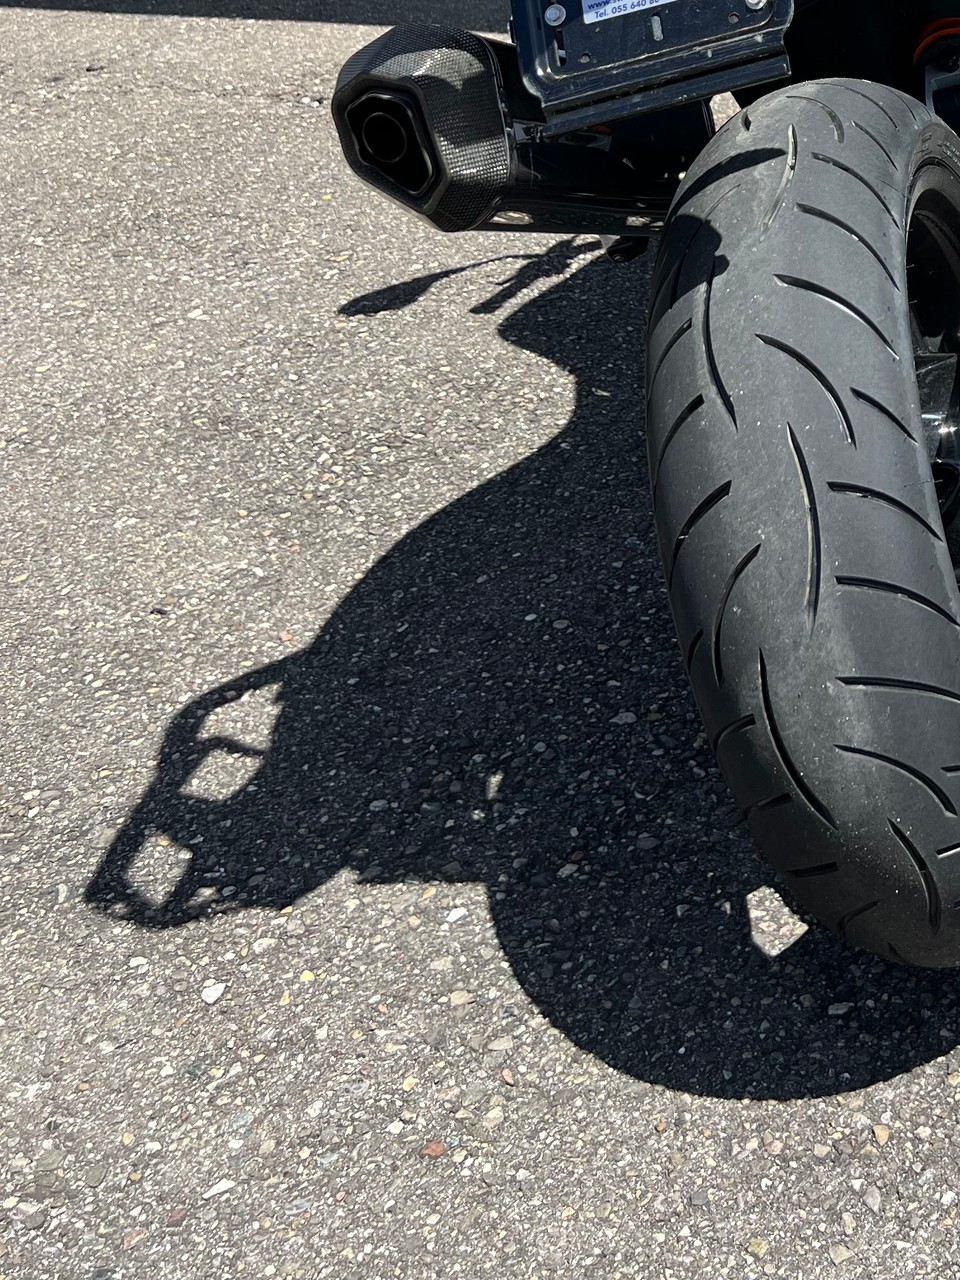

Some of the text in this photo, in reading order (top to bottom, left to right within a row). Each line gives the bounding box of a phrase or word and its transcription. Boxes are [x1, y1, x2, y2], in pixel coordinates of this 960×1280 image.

[594, 9, 609, 19] Tel.
[611, 4, 628, 14] 055
[630, 0, 647, 9] 640
